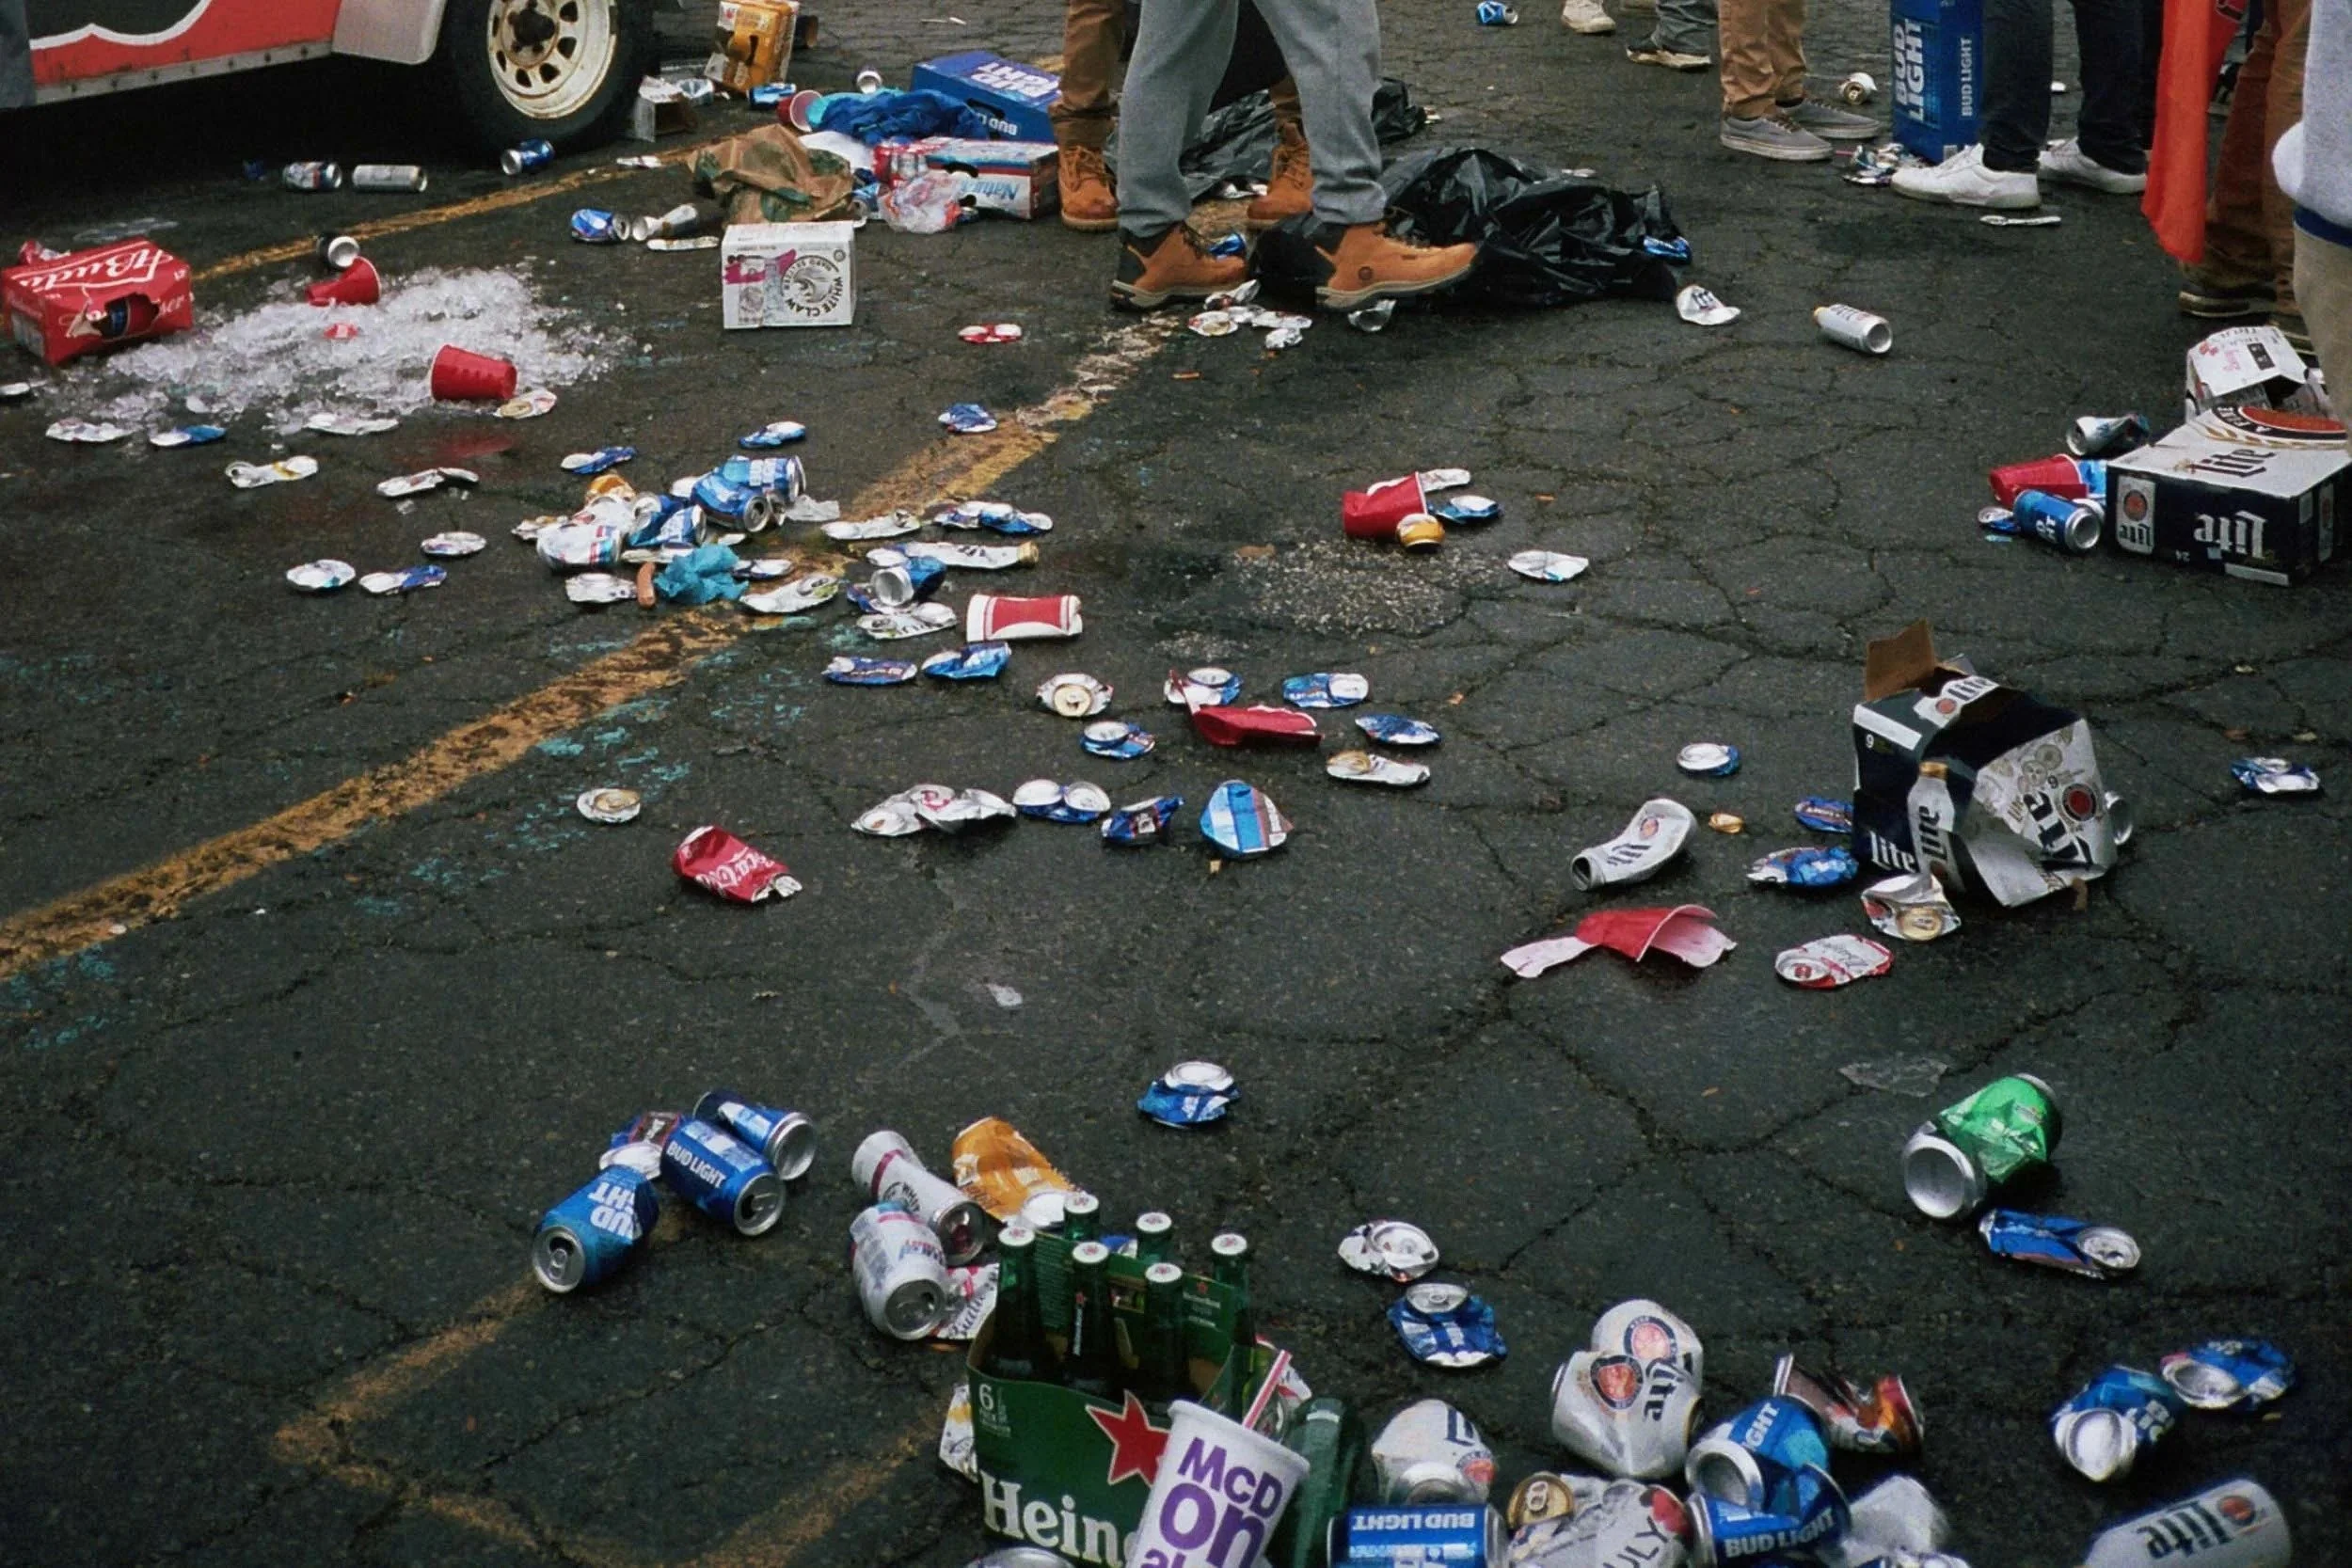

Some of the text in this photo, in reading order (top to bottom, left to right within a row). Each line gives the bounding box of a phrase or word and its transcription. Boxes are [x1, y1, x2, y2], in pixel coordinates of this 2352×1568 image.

[1893, 24, 1908, 105] BUD
[1904, 19, 1925, 121] LIGHT
[1961, 37, 1973, 118] BUD LIGHT
[988, 117, 1018, 136] BUD
[785, 276, 844, 317] WHITE CLAW
[2189, 448, 2277, 478] Lite
[2120, 523, 2152, 546] Lite
[2193, 511, 2268, 560] Lite
[1866, 734, 1875, 749] 9
[1869, 831, 1920, 873] Lite
[1918, 805, 1948, 862] Lite
[2024, 791, 2095, 873] Lite
[666, 1140, 727, 1189] BUD LIGHT
[978, 1384, 994, 1410] 6
[1352, 1512, 1476, 1531] BUD LIGHT
[1724, 1507, 1835, 1558] BUD LIGHT
[2136, 1501, 2233, 1560] Lite
